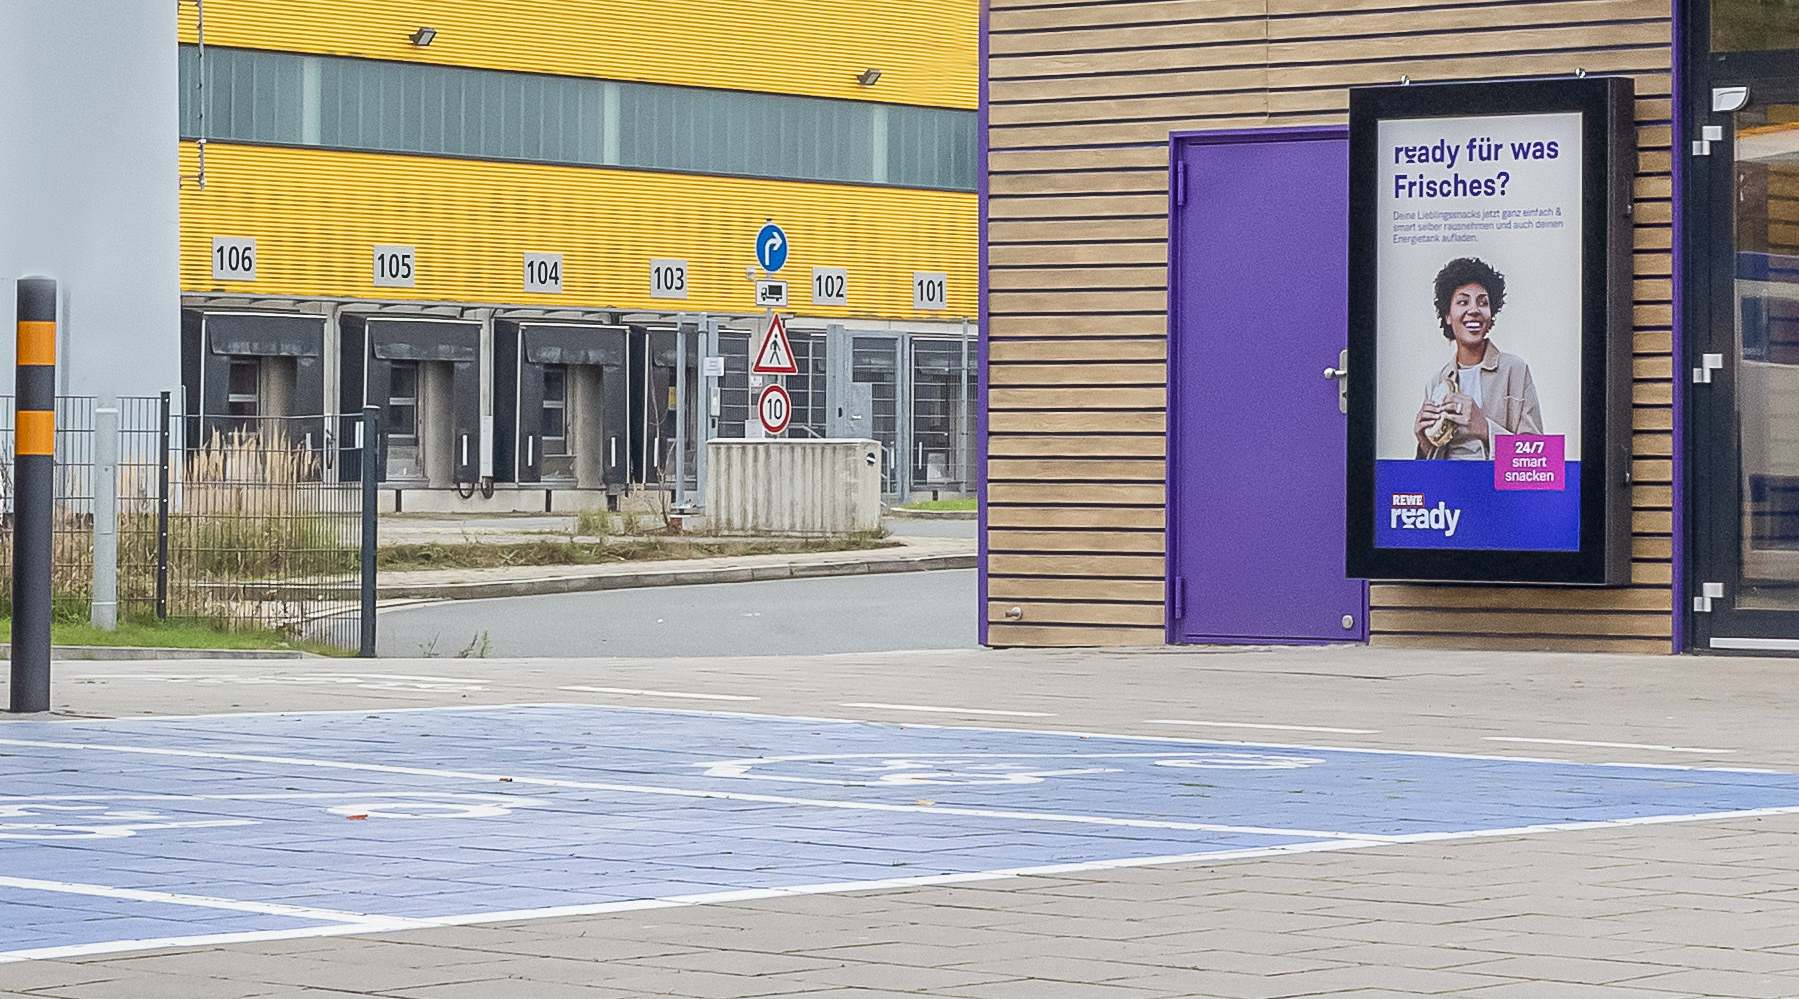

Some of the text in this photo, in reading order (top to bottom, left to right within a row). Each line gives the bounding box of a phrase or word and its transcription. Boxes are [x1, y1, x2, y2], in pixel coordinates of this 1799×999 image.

[1395, 137, 1559, 169] ready für was
[1394, 171, 1510, 199] Frisches?
[1393, 210, 1415, 221] Deine
[1481, 208, 1500, 221] jetzt
[1501, 209, 1521, 220] ganz
[1522, 207, 1553, 217] einfach
[1496, 220, 1512, 230] und
[1513, 219, 1533, 229] auch
[216, 245, 253, 272] 106
[377, 253, 412, 279] 105
[527, 260, 560, 286] 104
[654, 267, 685, 291] 103
[815, 274, 845, 299] 102
[917, 279, 944, 303] 101
[767, 398, 783, 420] 10
[1515, 441, 1544, 454] 24/7
[1512, 456, 1547, 468] smart
[1505, 469, 1554, 482] snacken
[1392, 494, 1423, 506] REWE
[1390, 501, 1461, 537] ready
